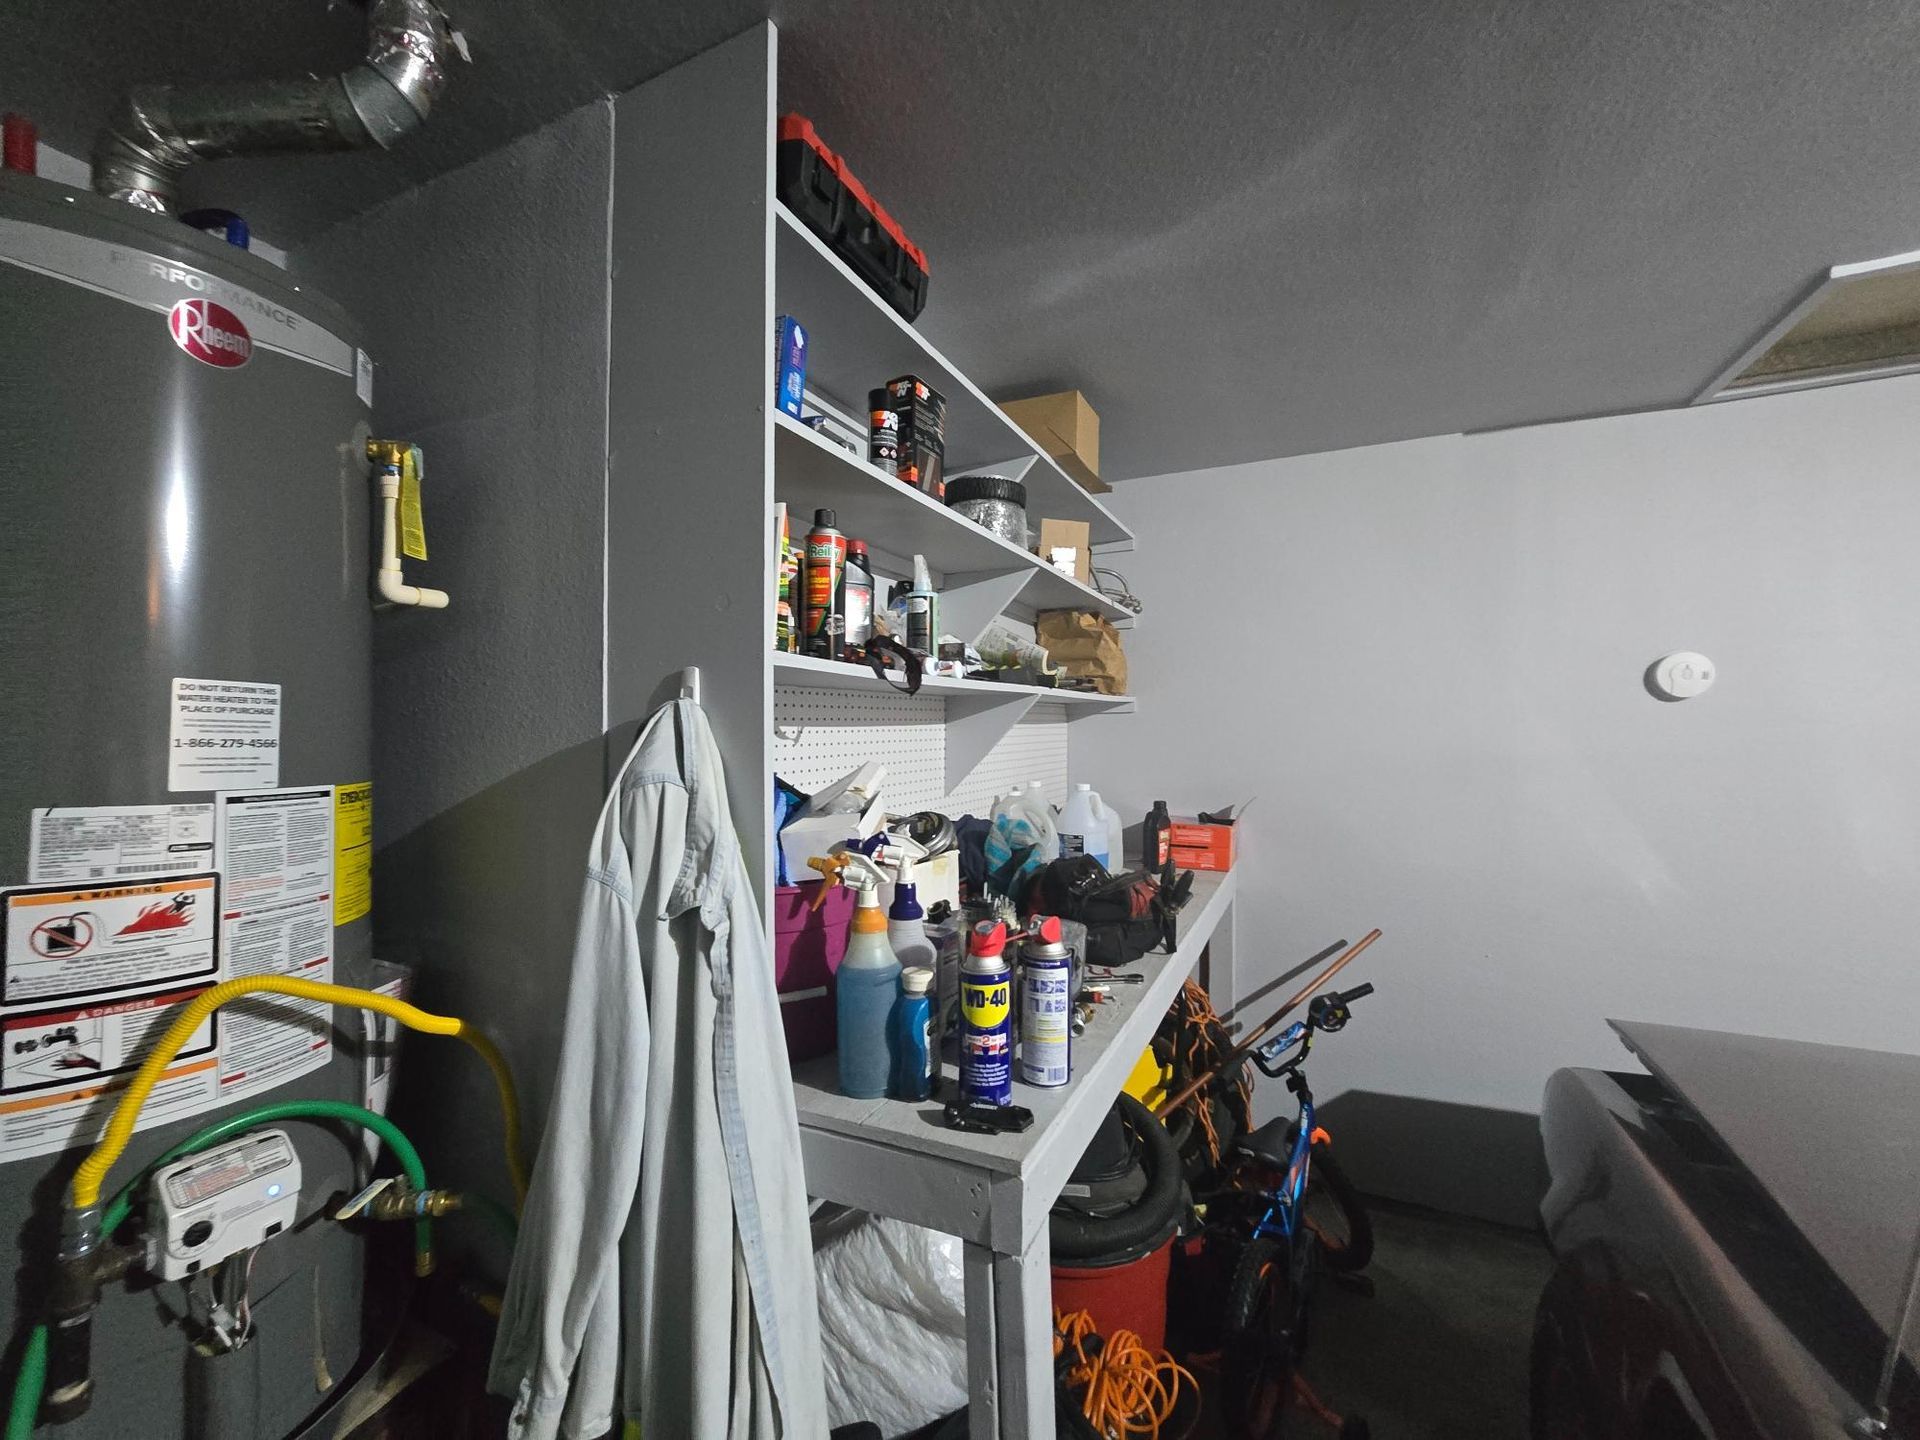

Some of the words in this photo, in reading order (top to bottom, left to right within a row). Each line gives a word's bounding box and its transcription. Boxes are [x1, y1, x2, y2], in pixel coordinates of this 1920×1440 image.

[176, 300, 250, 356] Rheem
[180, 683, 195, 691] DO
[198, 684, 218, 692] NOT
[221, 685, 257, 694] RETURN
[259, 687, 277, 695] THIS
[177, 694, 211, 703] WATER
[213, 695, 248, 704] HEATER
[250, 697, 261, 705] TO
[181, 705, 213, 713] PLACE
[229, 707, 275, 715] PURCHASE
[174, 738, 278, 748] 1-866-279-4566
[91, 885, 162, 899] WARNING
[964, 987, 1007, 1009] WD-40
[92, 999, 156, 1016] DANGER
